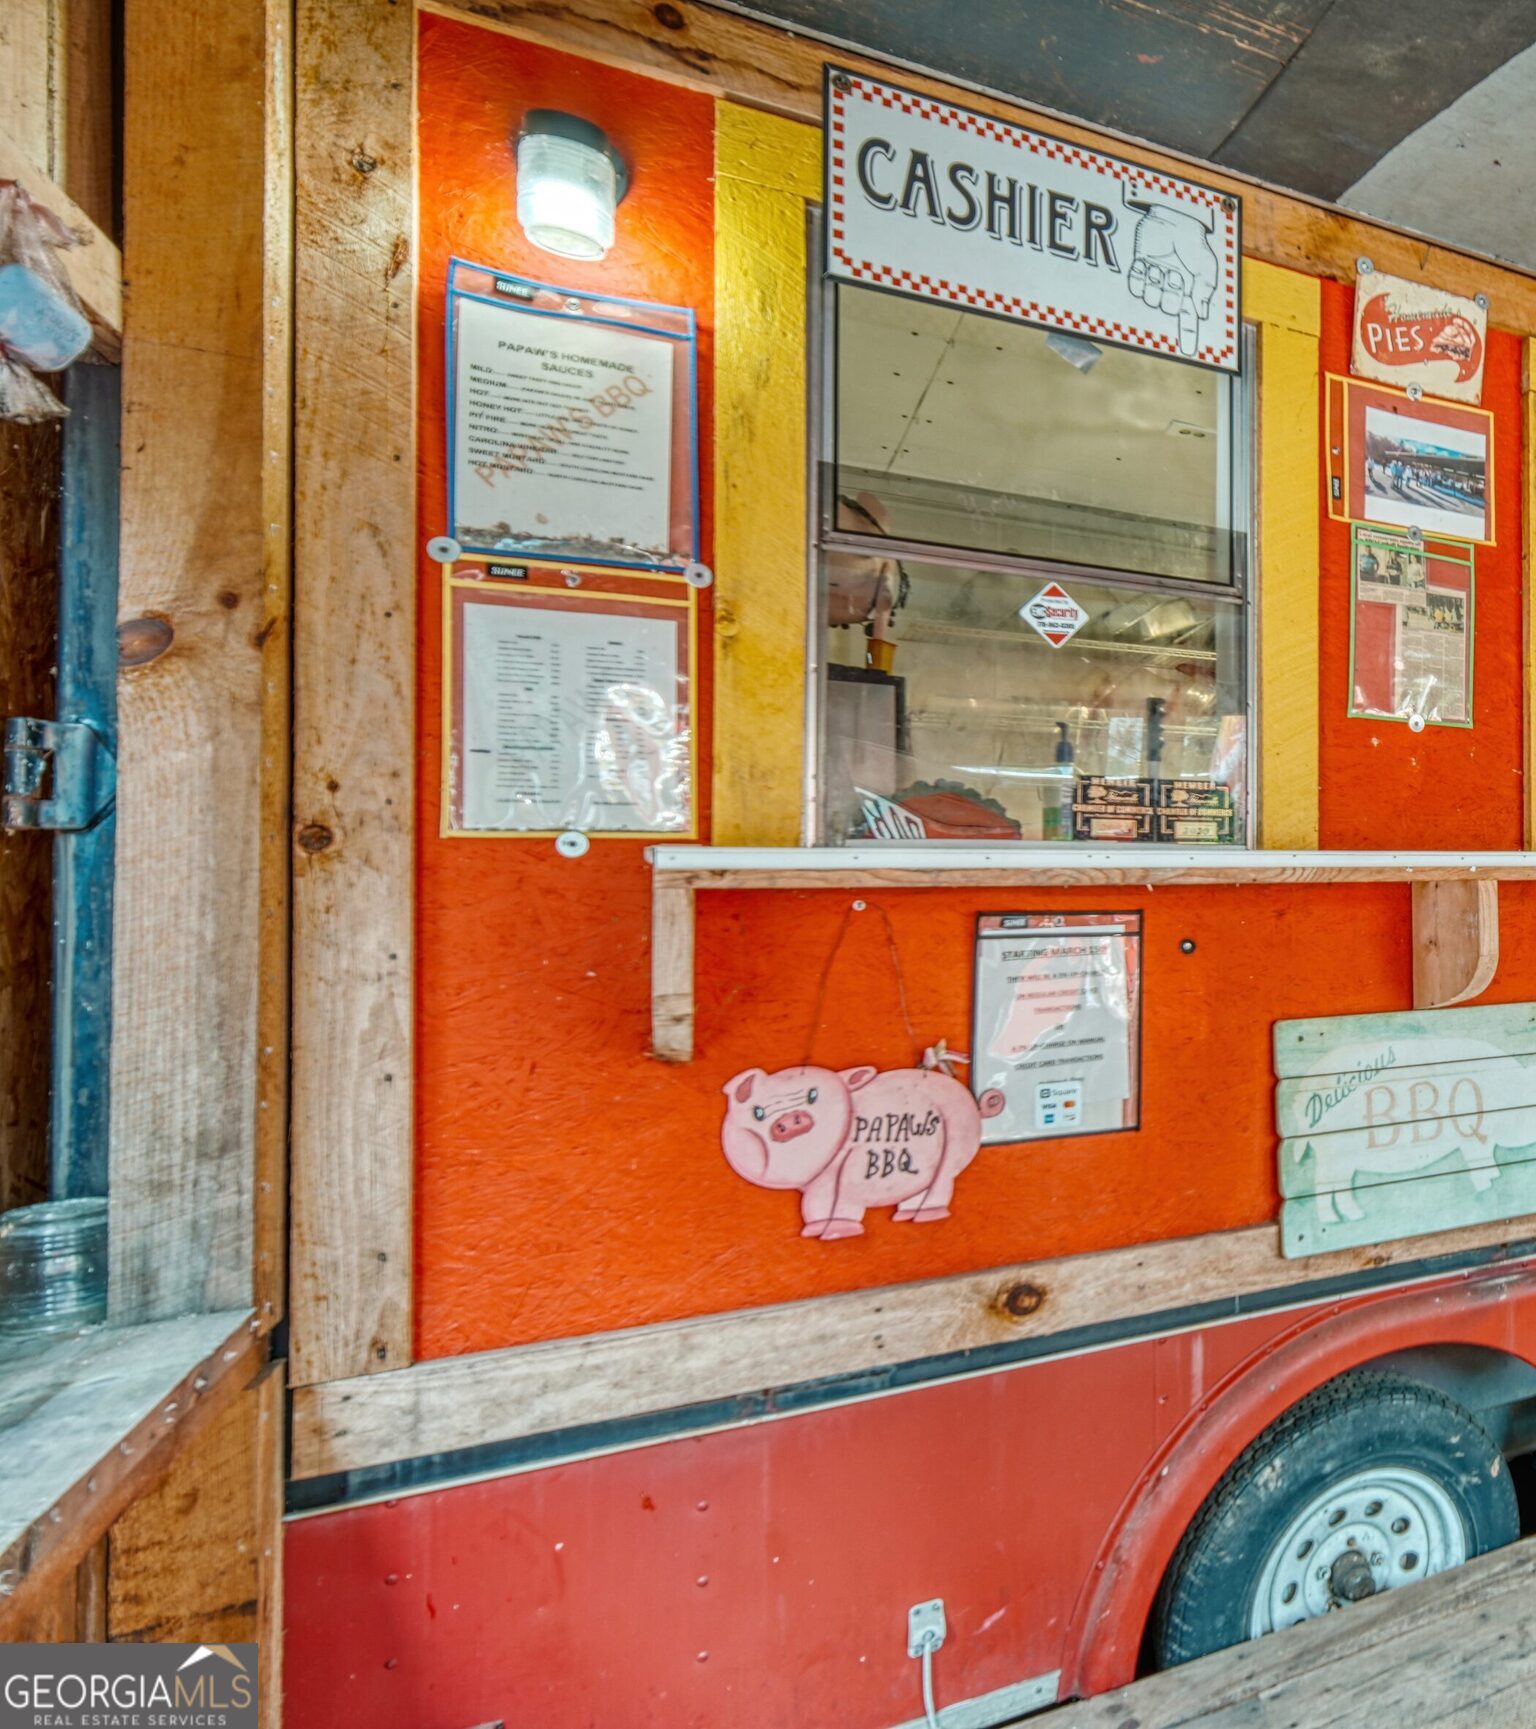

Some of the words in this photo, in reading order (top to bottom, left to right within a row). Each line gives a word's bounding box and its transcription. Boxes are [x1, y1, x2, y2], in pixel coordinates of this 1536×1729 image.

[857, 137, 1122, 274] CASHIER
[1367, 323, 1425, 354] PIES
[541, 361, 595, 379] SAUCES
[561, 352, 636, 374] HOMEMADE
[589, 375, 651, 418] BBQ
[1173, 780, 1217, 790] MEMBER
[1304, 1046, 1397, 1129] Delicious
[1362, 1077, 1488, 1149] BBQ
[864, 1148, 919, 1179] BBQ
